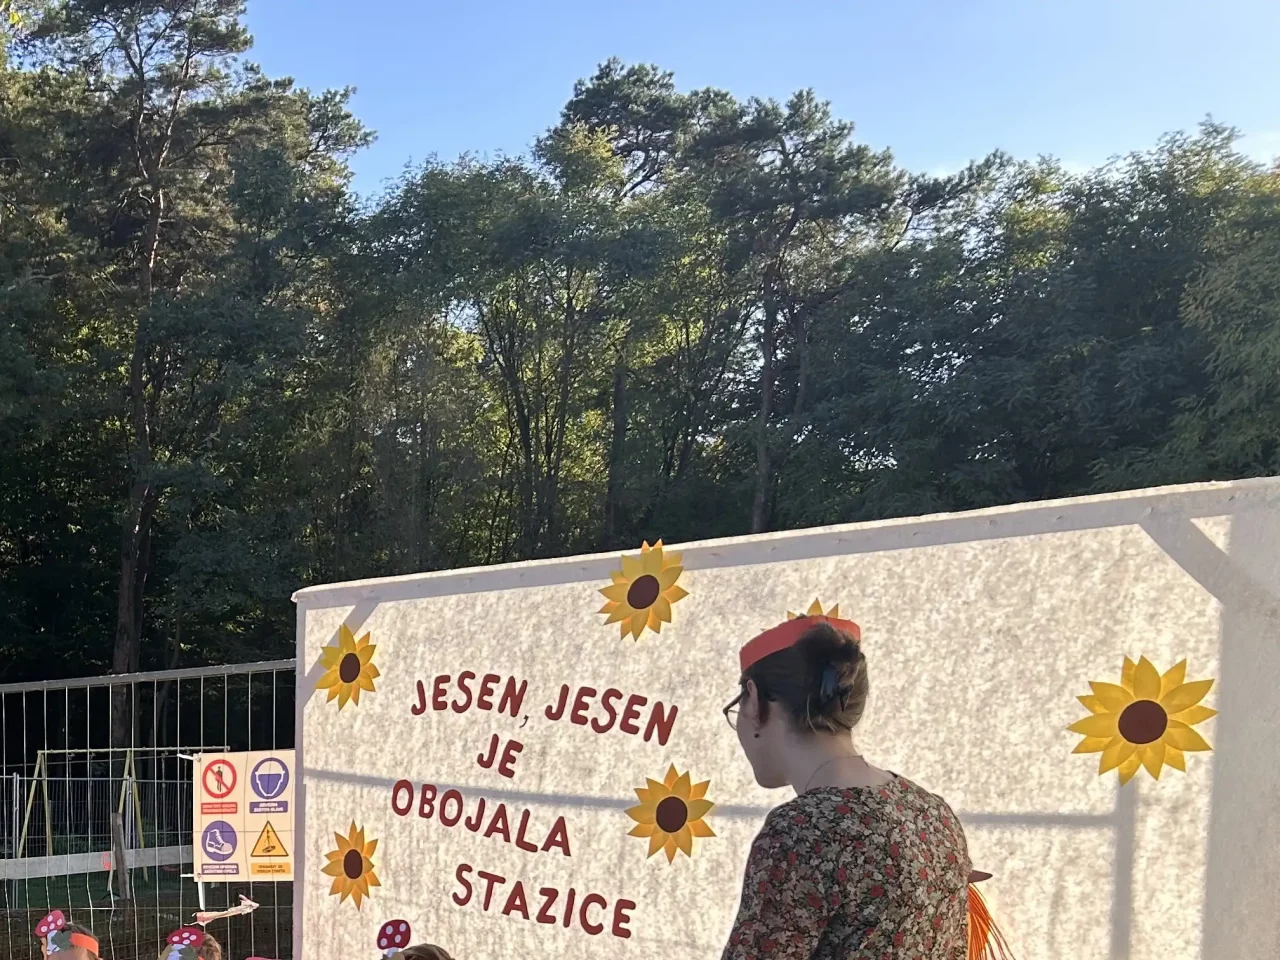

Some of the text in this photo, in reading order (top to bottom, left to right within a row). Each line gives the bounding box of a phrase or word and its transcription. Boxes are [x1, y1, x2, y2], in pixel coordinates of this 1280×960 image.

[410, 670, 678, 746] JESEN, JESEN
[477, 733, 524, 778] JE
[391, 779, 571, 857] OBOJALA
[452, 863, 637, 939] STAZICE
